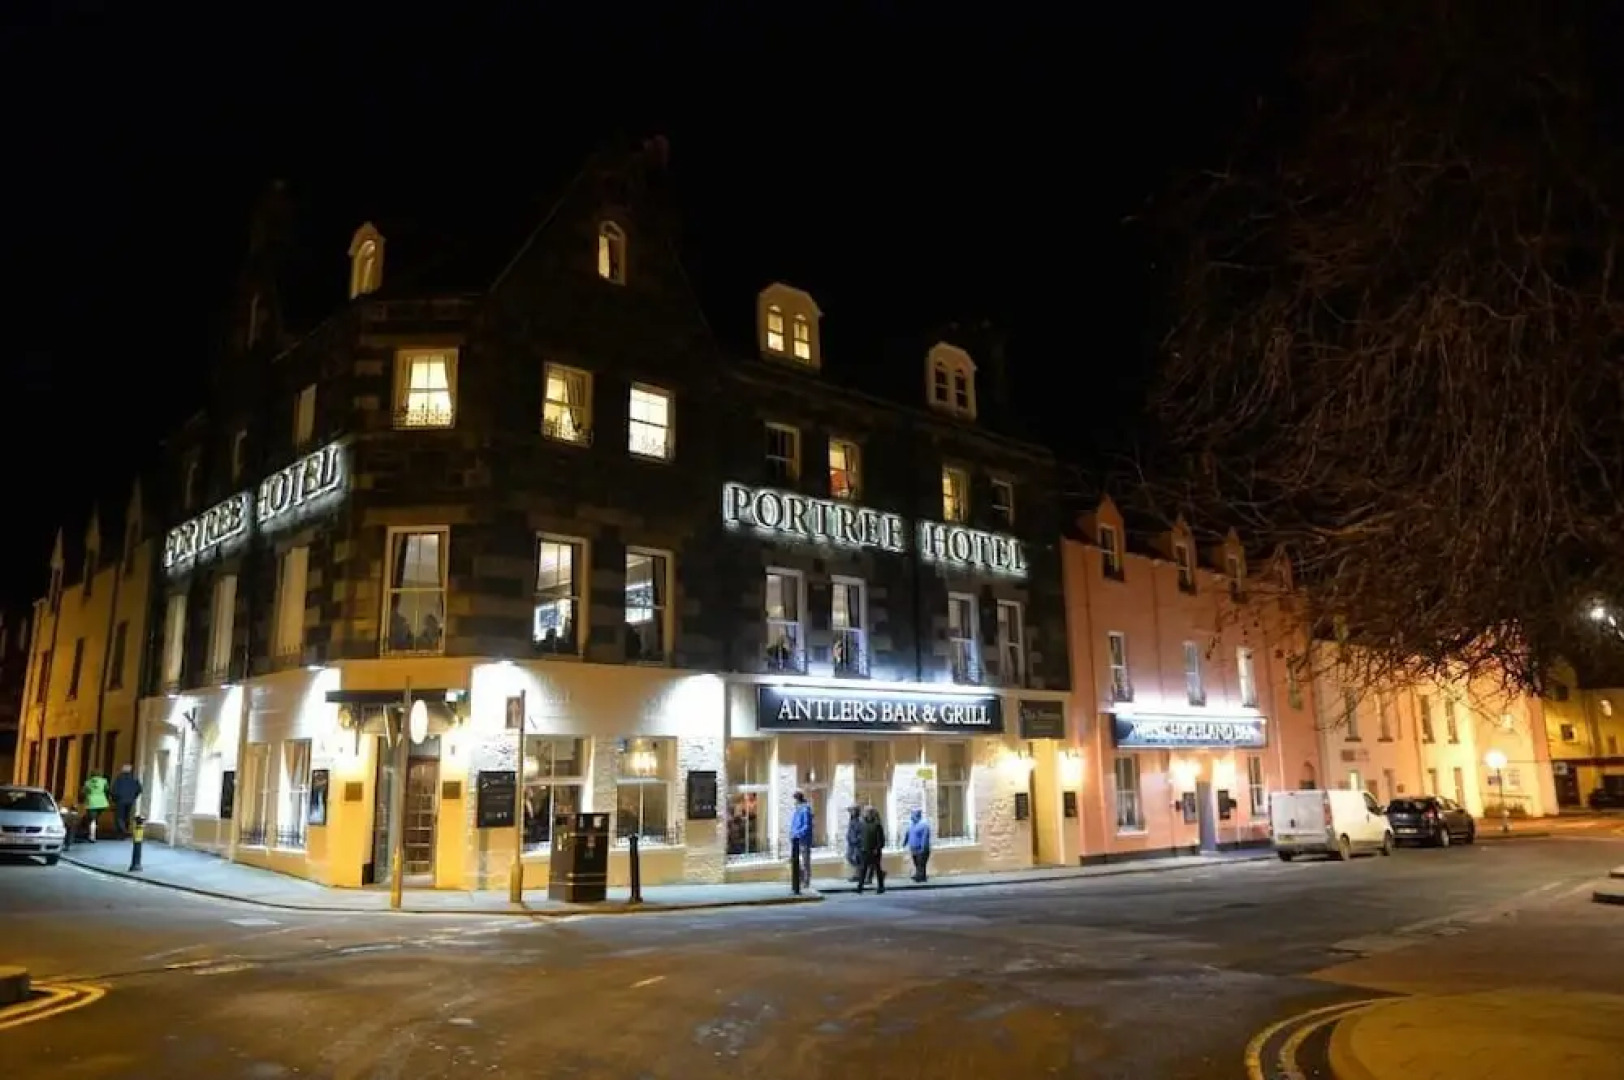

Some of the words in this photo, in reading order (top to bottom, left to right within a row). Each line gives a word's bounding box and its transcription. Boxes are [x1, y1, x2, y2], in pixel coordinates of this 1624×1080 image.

[723, 483, 903, 551] PORTREE
[919, 519, 1026, 573] HOTEL
[777, 696, 877, 723] ANTLERS
[881, 700, 919, 723] BAR
[921, 703, 938, 722] &
[940, 703, 992, 725] GRILL
